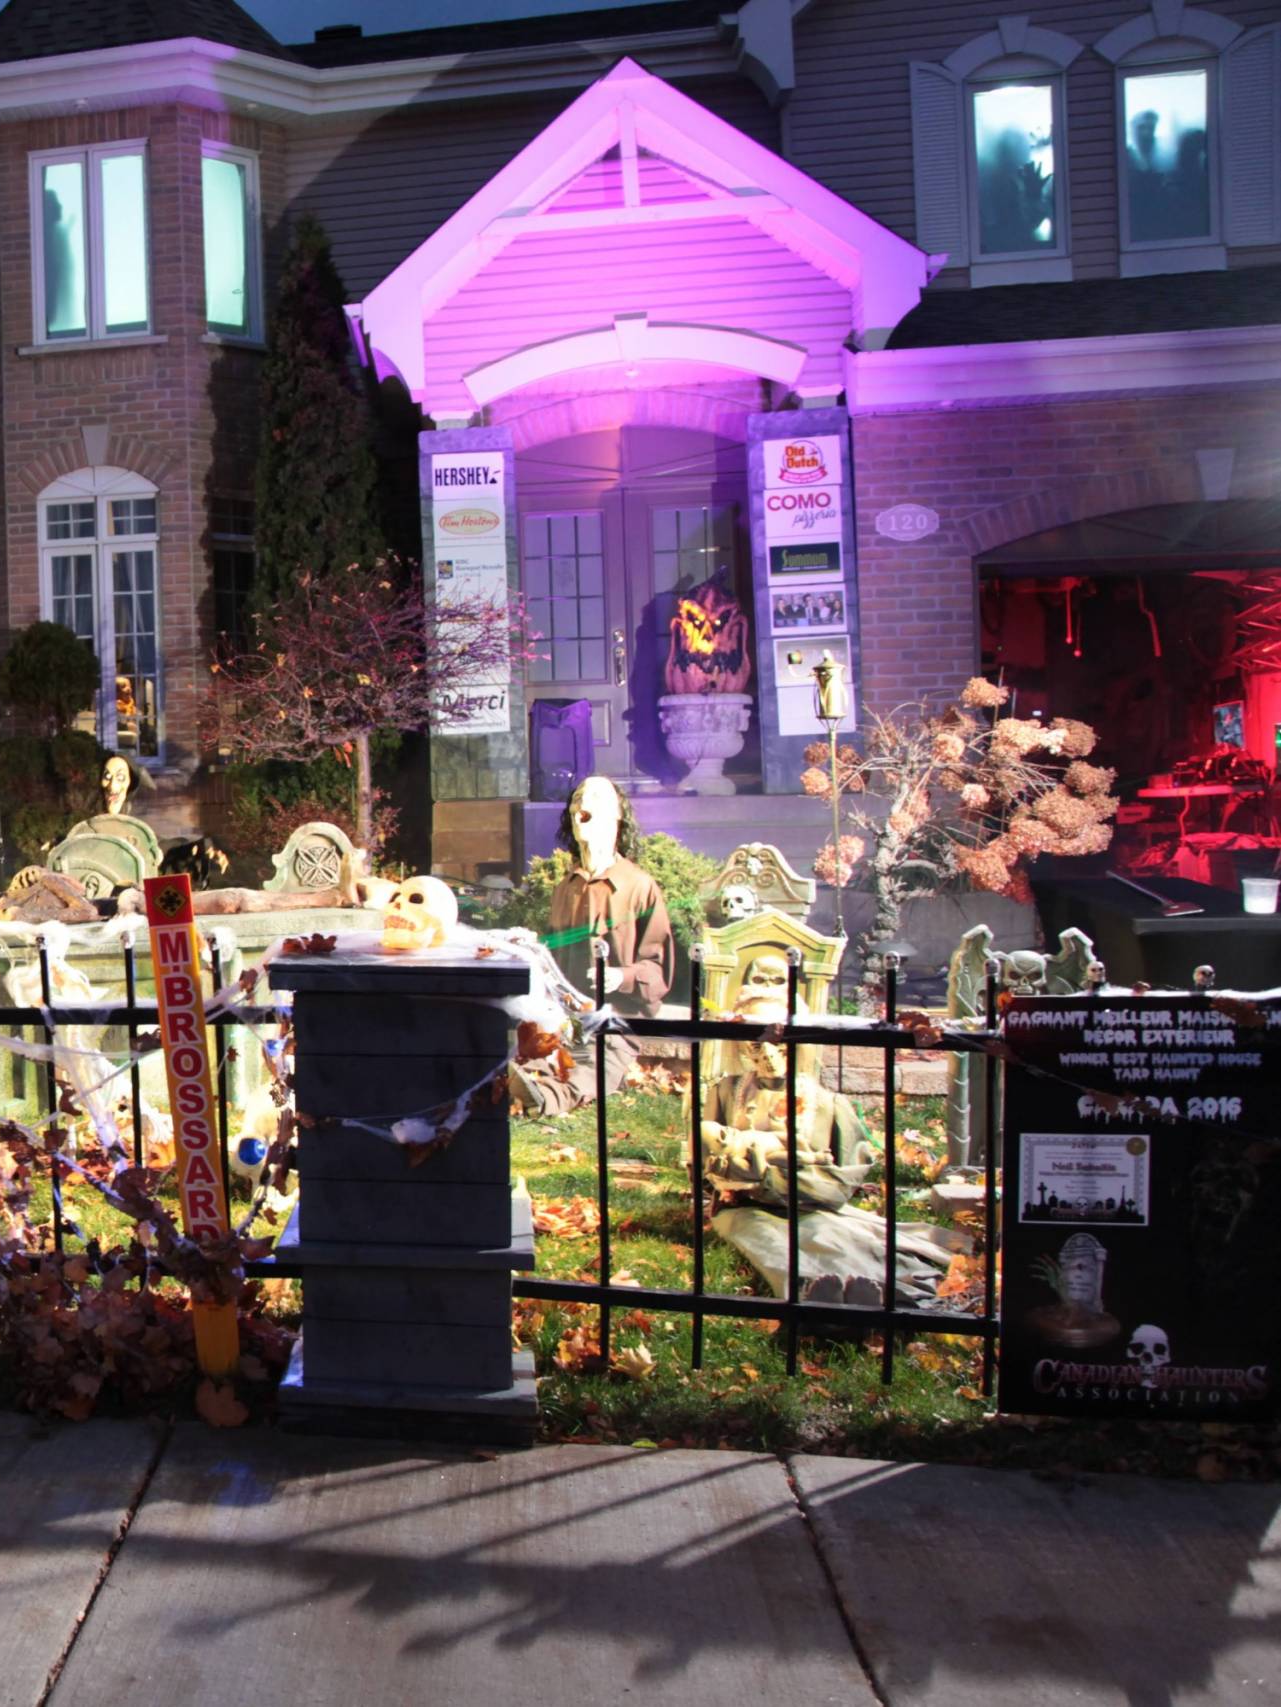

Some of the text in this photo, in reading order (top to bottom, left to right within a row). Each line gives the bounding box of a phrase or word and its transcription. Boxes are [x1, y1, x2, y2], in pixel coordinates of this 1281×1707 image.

[785, 446, 805, 457] Old
[787, 457, 819, 468] Dutch
[767, 492, 831, 511] COMO
[889, 514, 928, 530] 120
[1008, 1011, 1087, 1028] GAGNANT
[1060, 1053, 1262, 1066] WINNER BEST HAUNTED HOUSE
[1113, 1068, 1201, 1082] YARD HAUNT
[1187, 1096, 1242, 1122] 2016
[1033, 1359, 1268, 1398] CANADIAN HAUNTERS
[1056, 1387, 1240, 1404] ASSOCIATION
